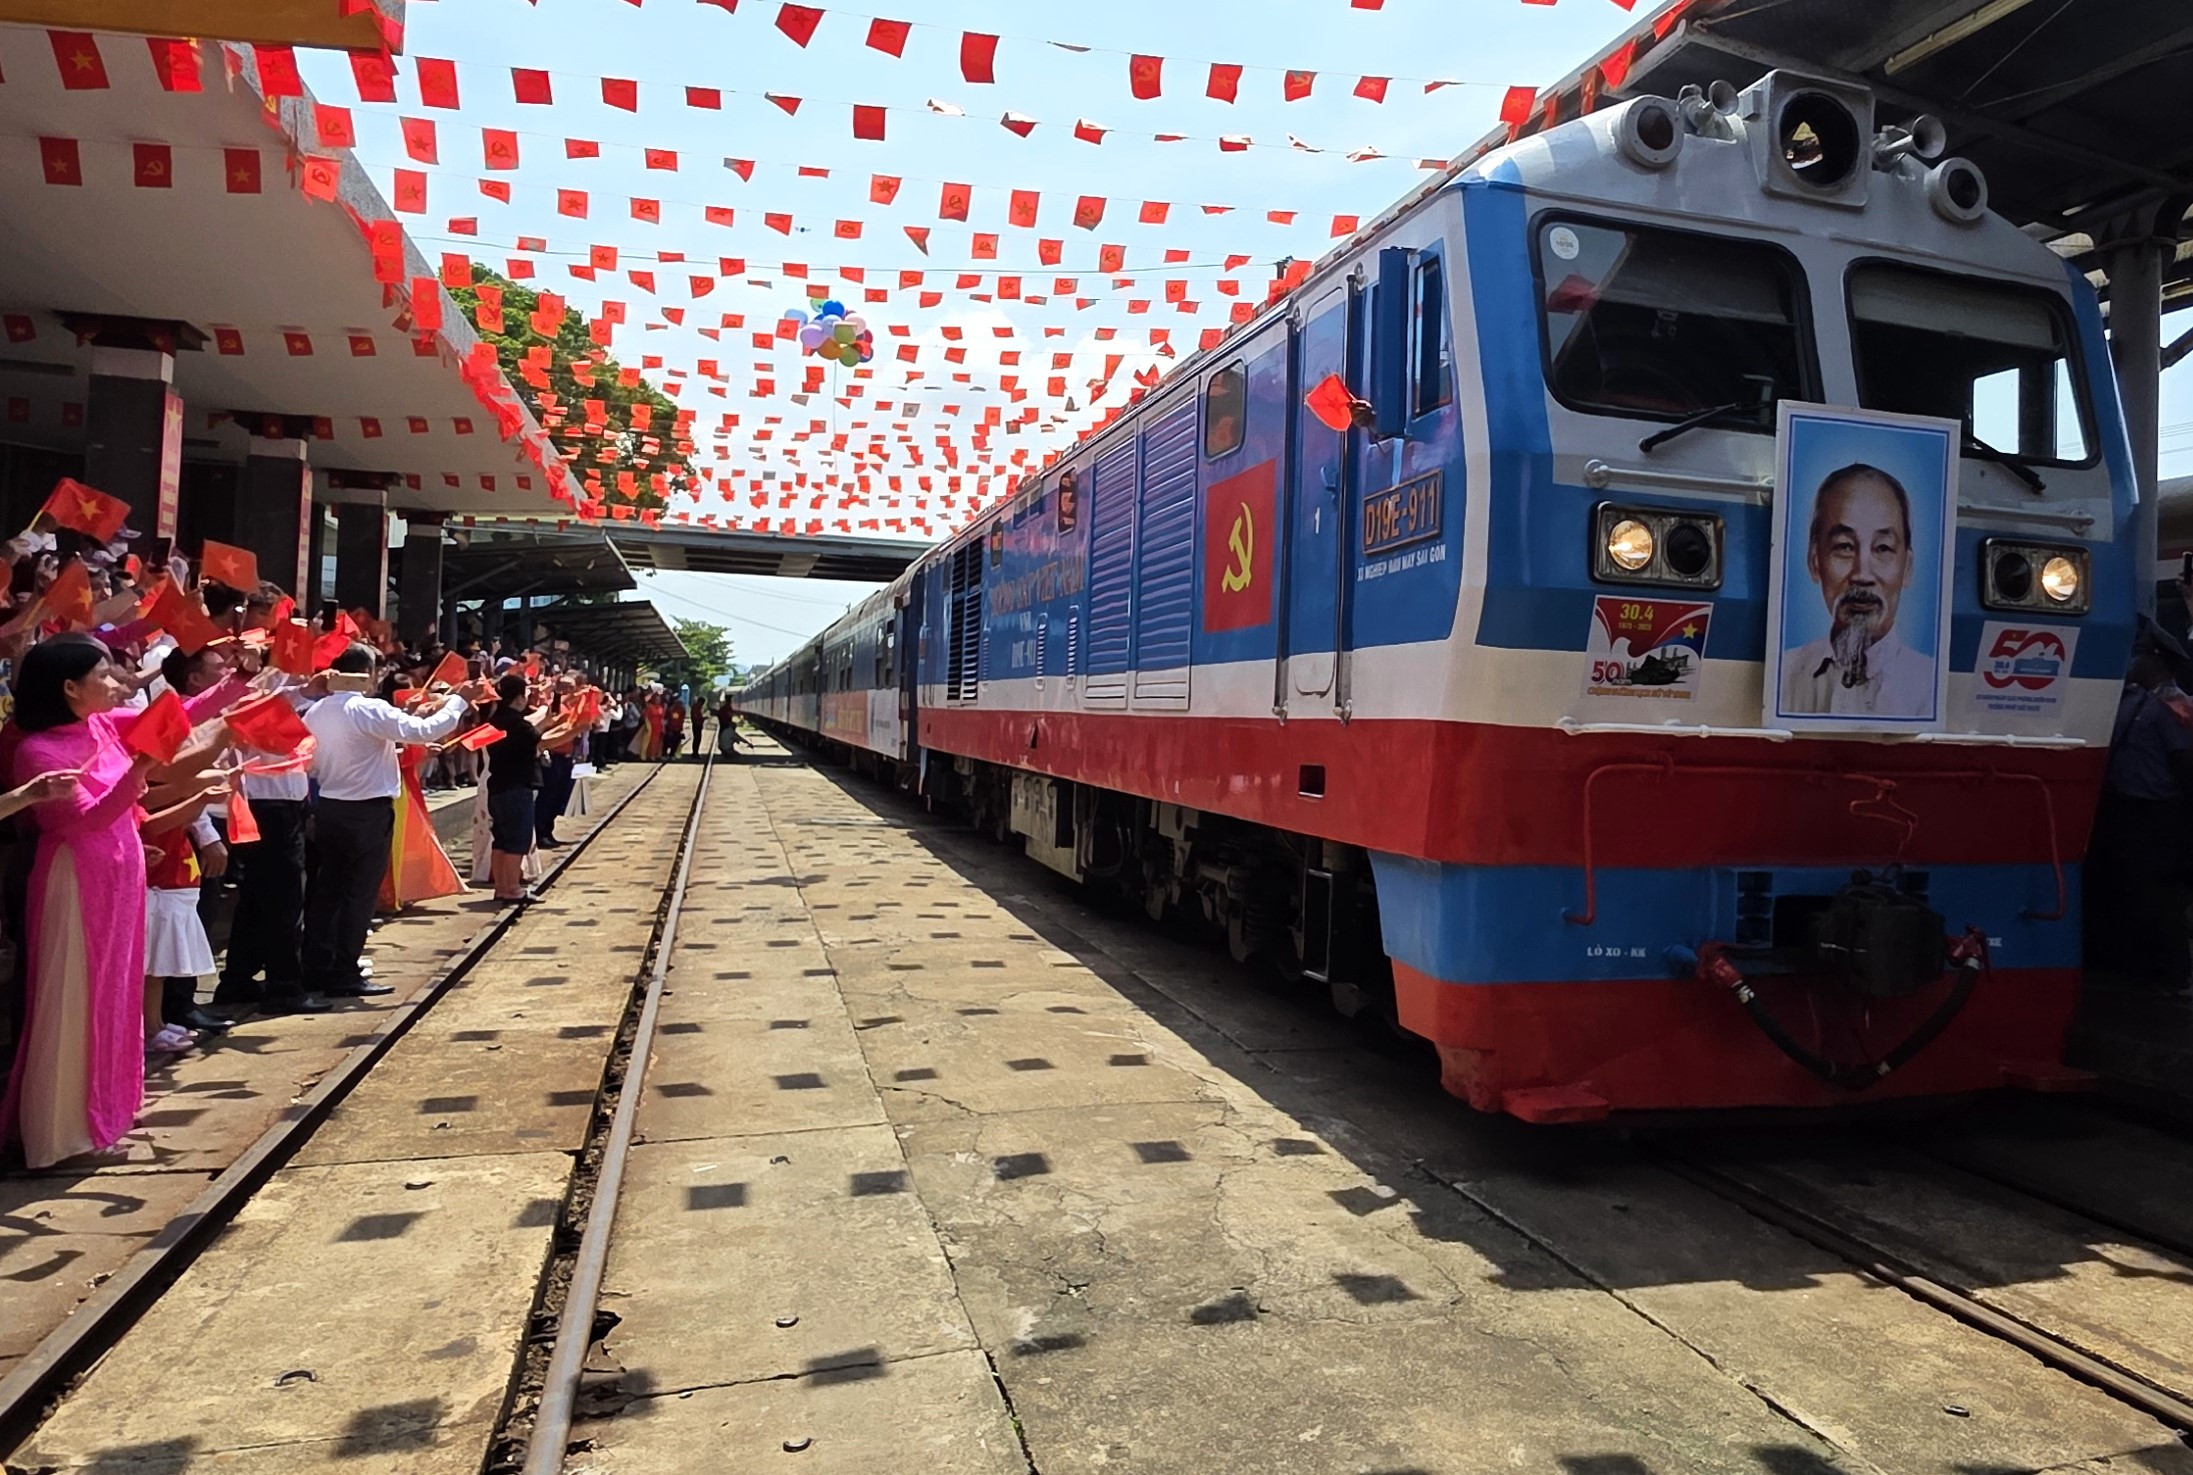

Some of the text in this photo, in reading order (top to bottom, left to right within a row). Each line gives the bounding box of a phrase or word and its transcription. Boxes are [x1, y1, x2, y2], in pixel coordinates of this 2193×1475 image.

[1315, 507, 1320, 534] 1
[1365, 481, 1436, 545] D19E-911
[1619, 603, 1654, 621] 30.4
[1591, 660, 1625, 684] 50
[1605, 947, 1621, 957] XO
